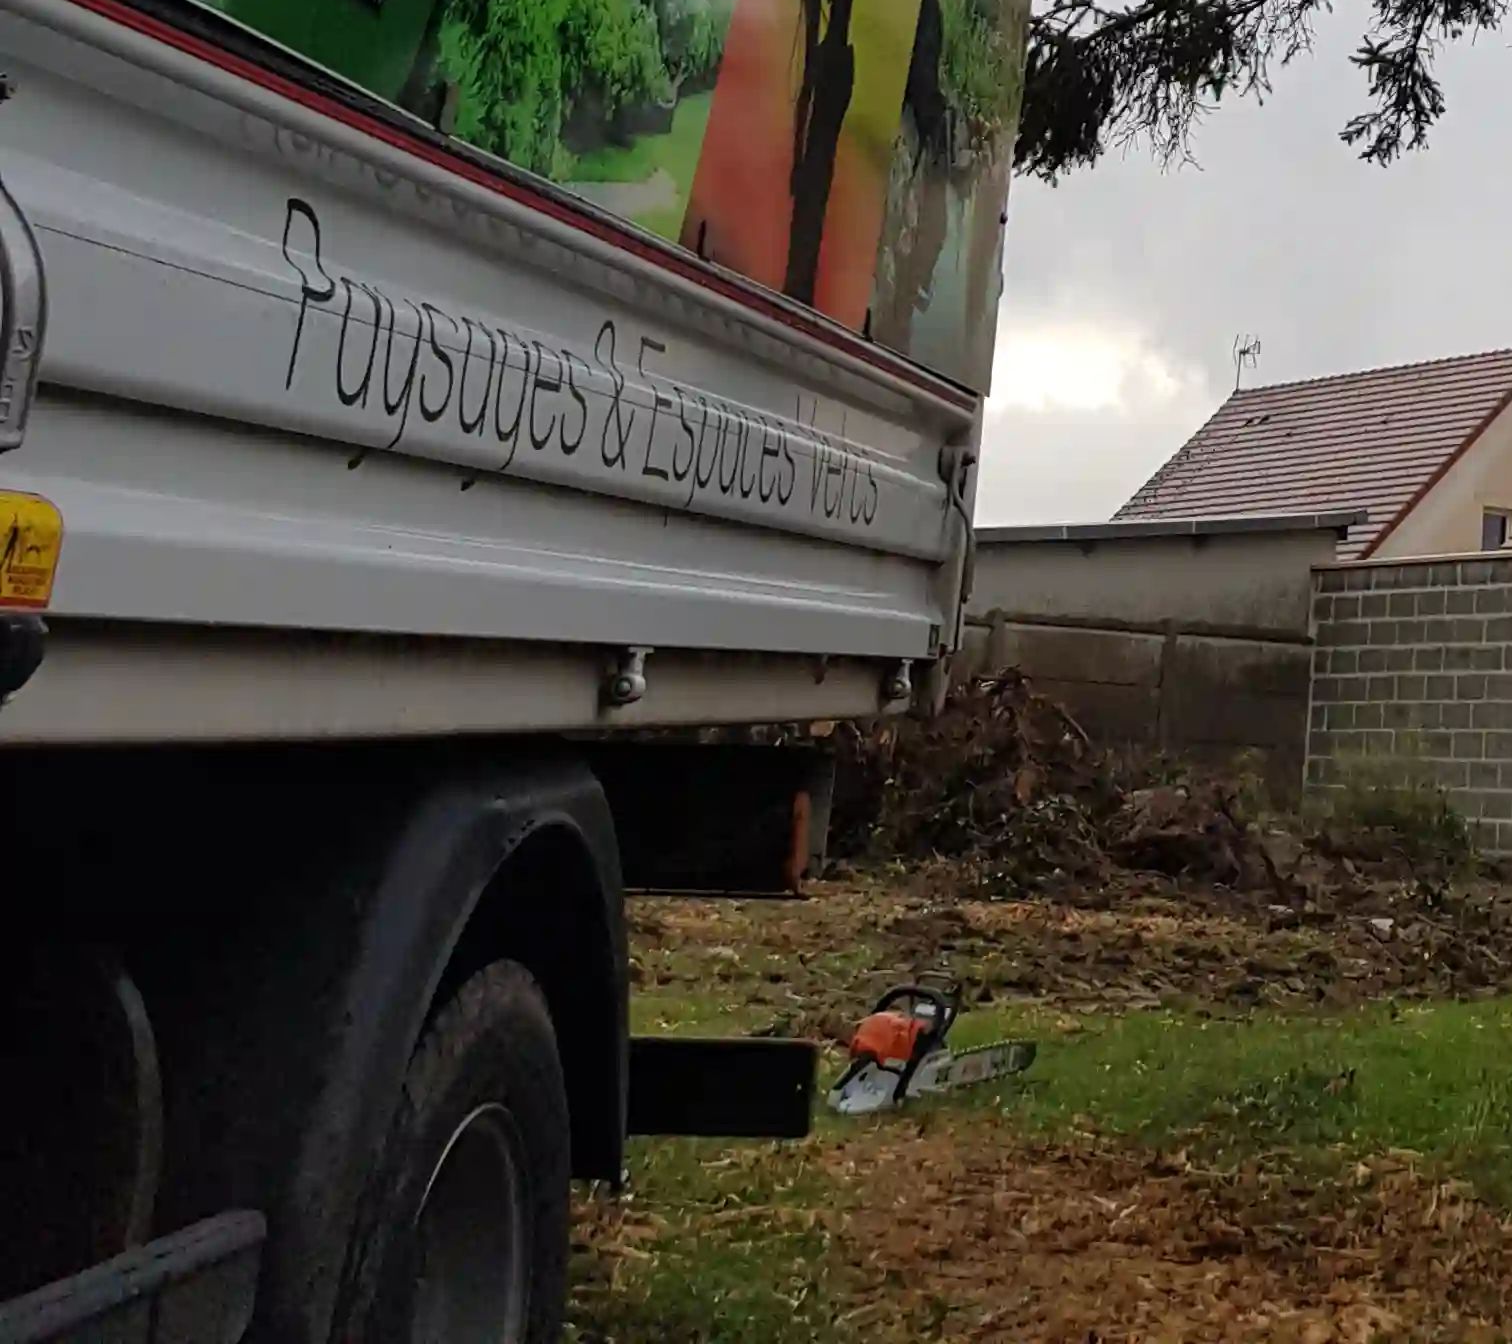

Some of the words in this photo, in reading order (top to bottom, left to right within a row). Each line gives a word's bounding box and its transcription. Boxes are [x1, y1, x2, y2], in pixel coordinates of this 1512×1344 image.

[283, 198, 592, 470] Paysages
[594, 320, 636, 470] &
[639, 336, 796, 508] Espaces
